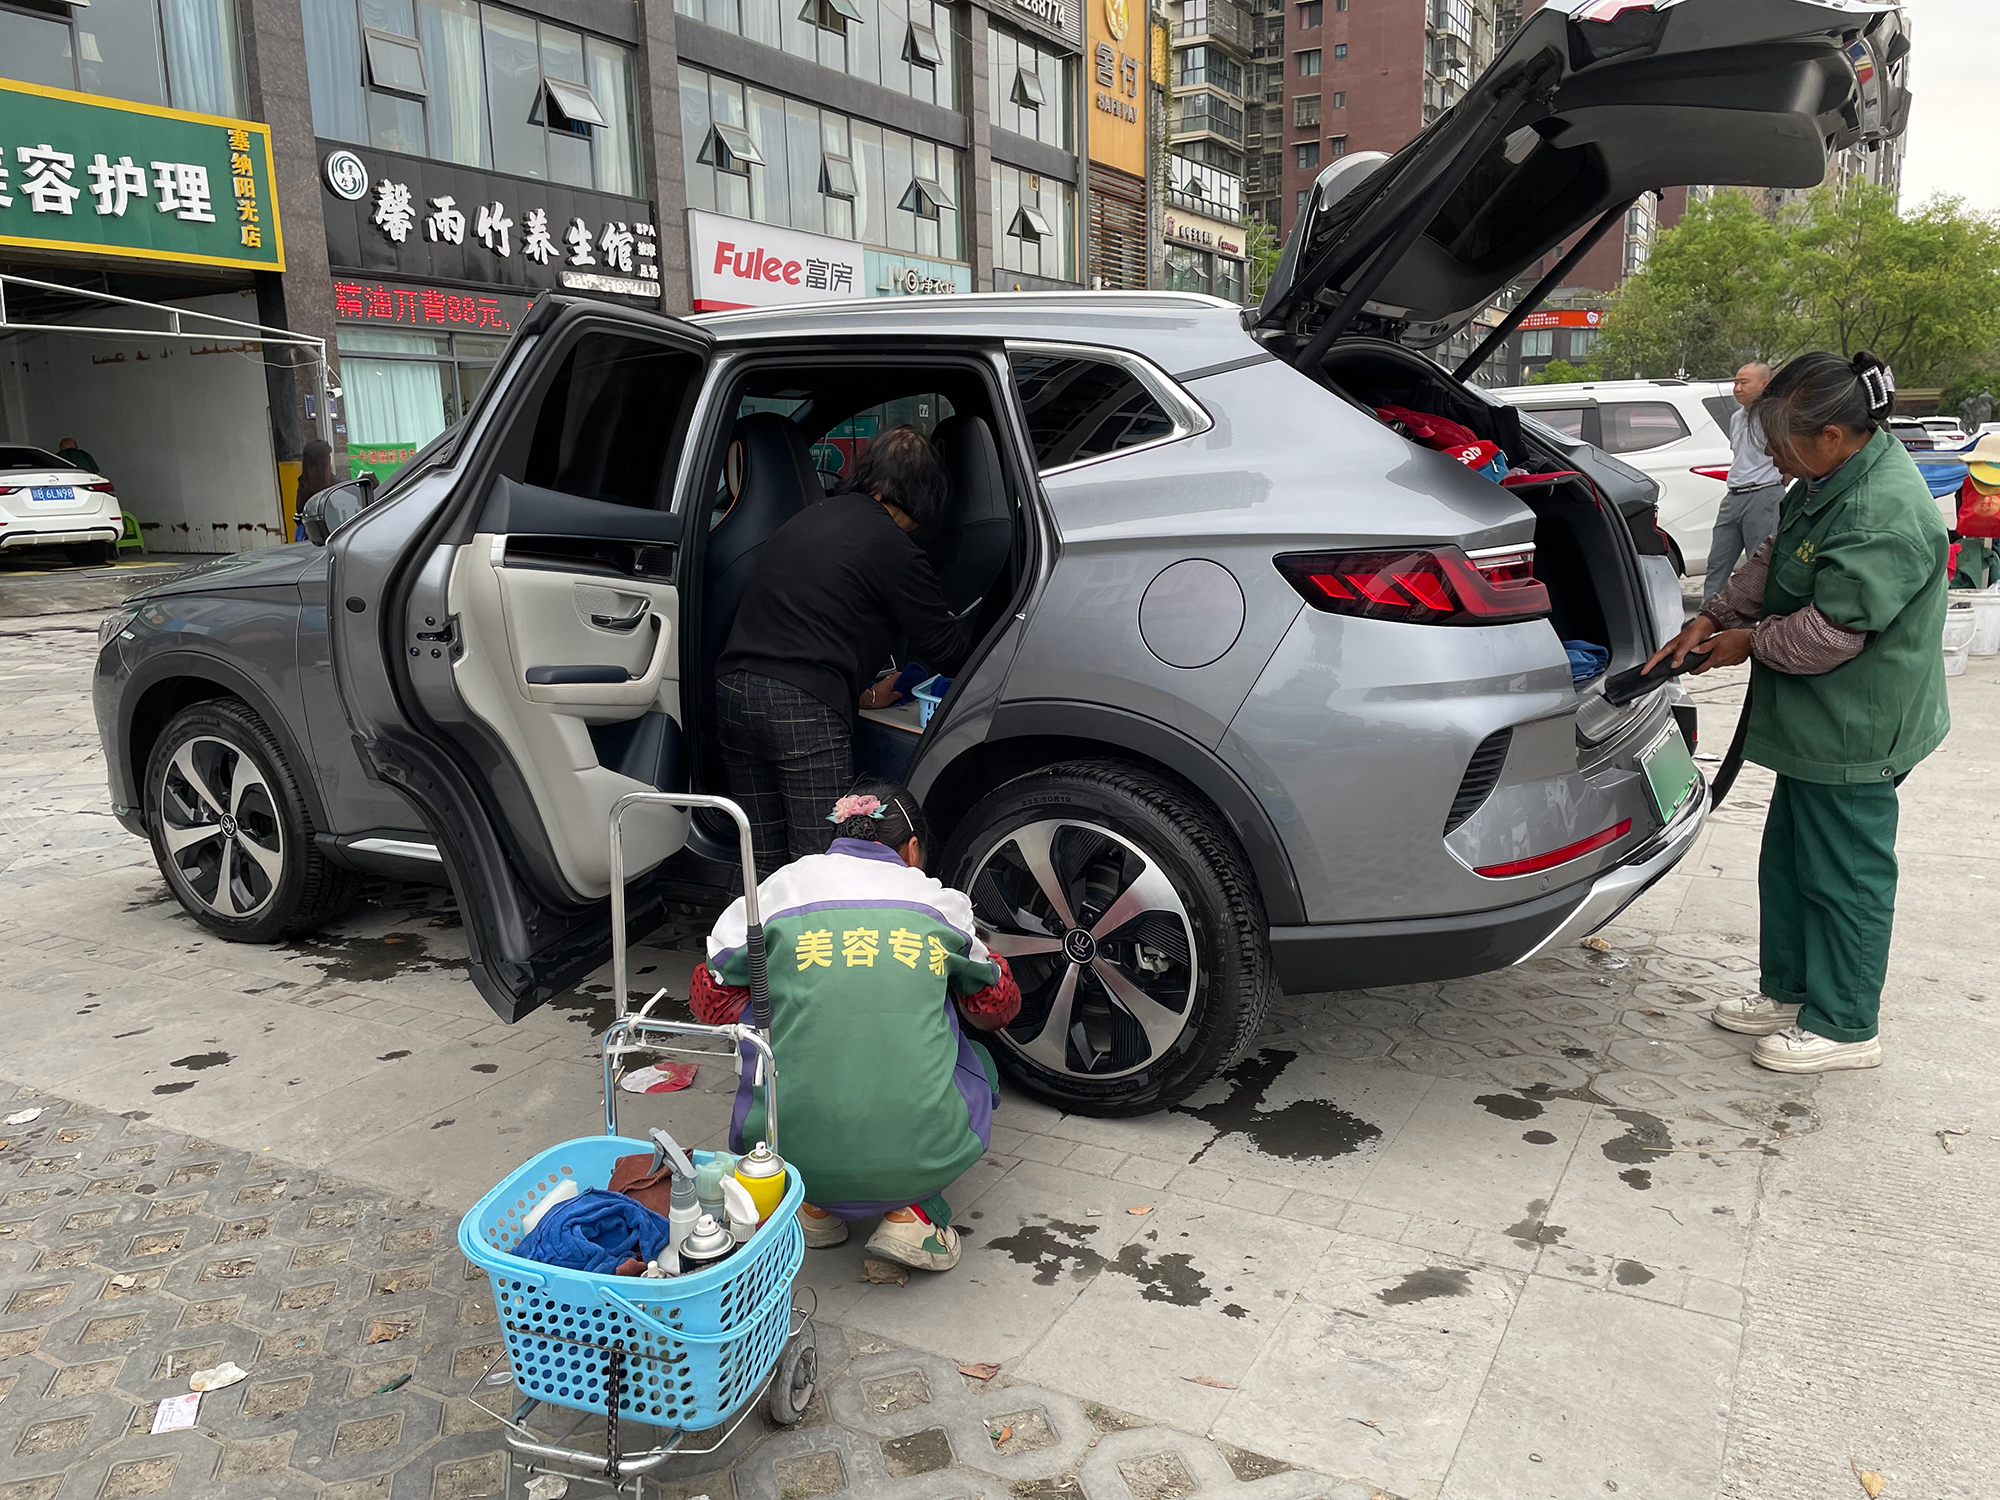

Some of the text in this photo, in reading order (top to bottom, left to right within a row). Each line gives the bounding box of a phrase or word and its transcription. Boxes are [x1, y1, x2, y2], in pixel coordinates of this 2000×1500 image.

[1097, 91, 1138, 124] SAFE PAY
[0, 143, 216, 223] 容护理
[228, 128, 262, 248] 塞纳阳光店
[372, 178, 634, 273] 馨雨竹养生馆
[634, 222, 657, 238] SPA
[713, 241, 853, 294] Fulee 富房
[334, 281, 533, 331] 精油开背88元，
[795, 926, 950, 976] 美容专家
